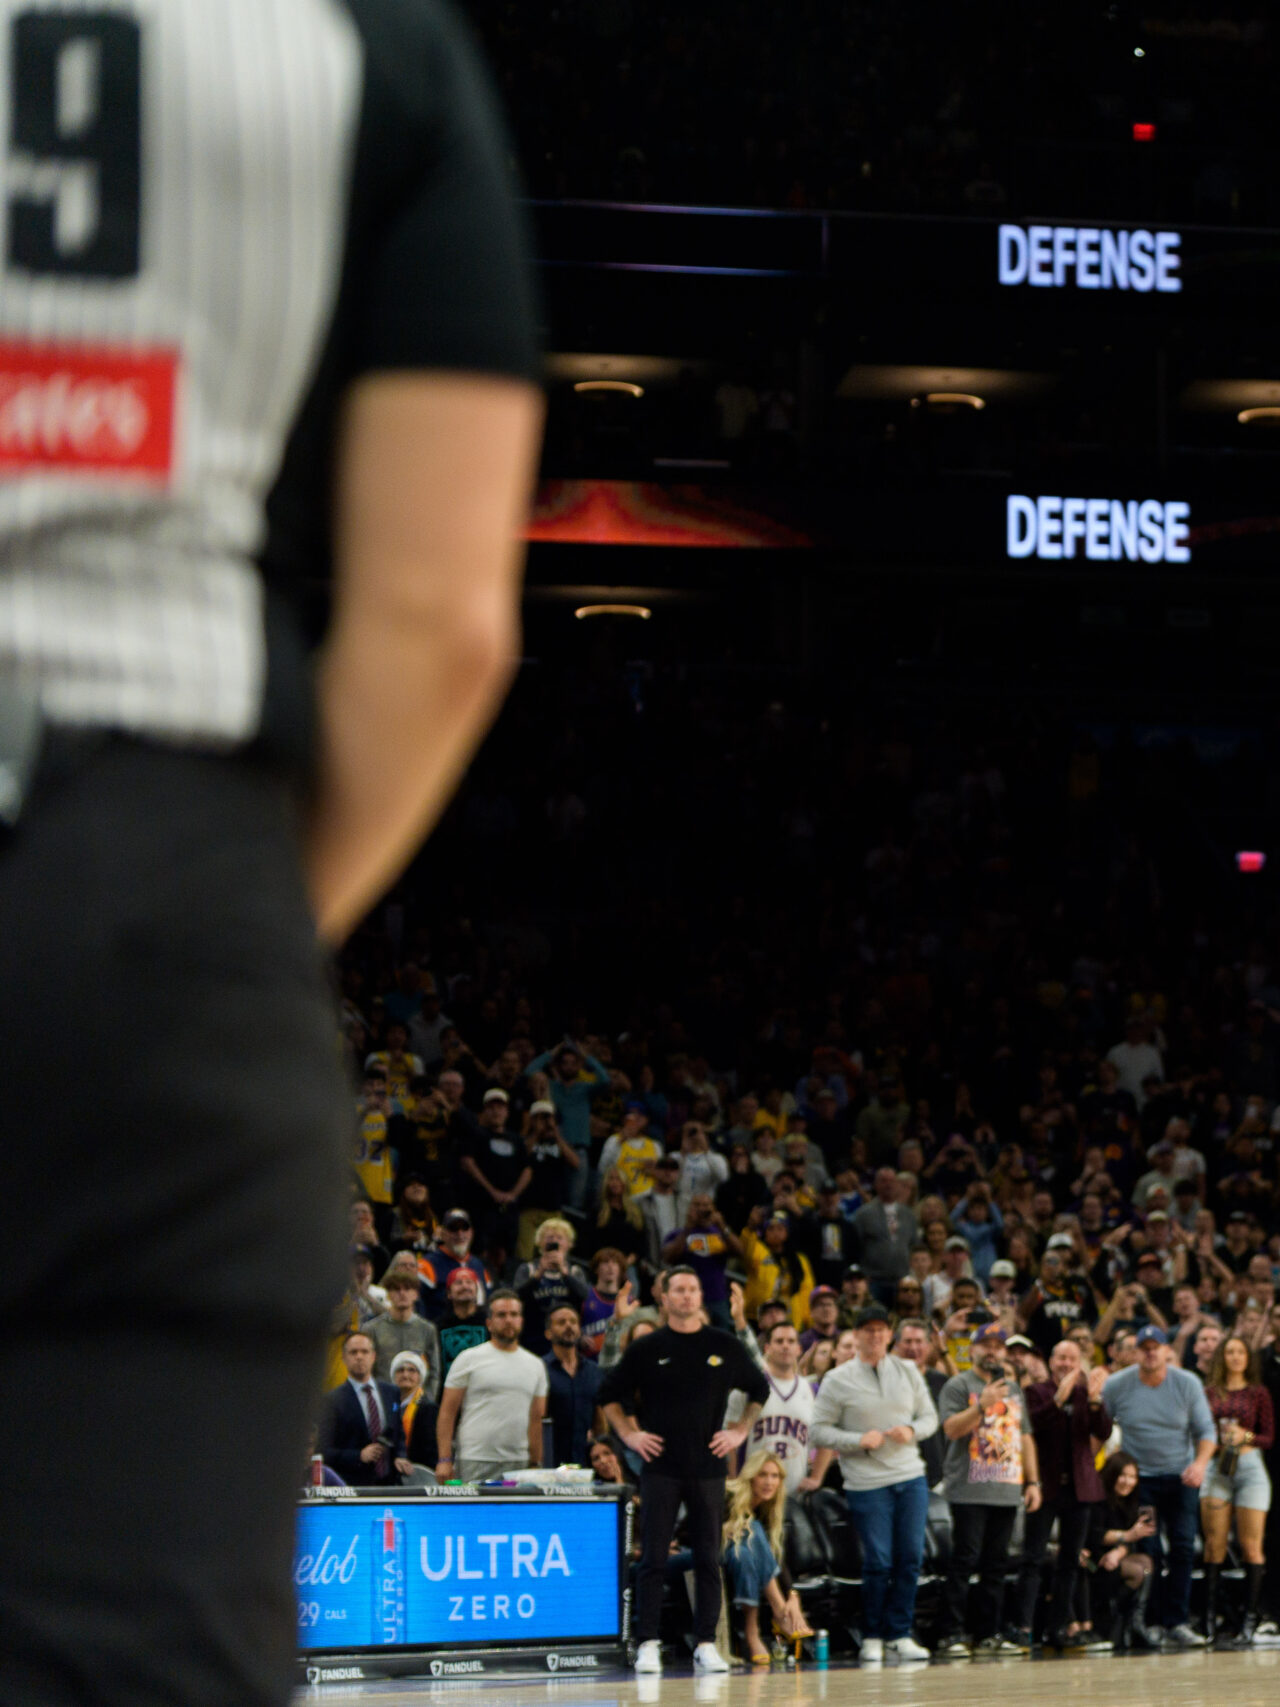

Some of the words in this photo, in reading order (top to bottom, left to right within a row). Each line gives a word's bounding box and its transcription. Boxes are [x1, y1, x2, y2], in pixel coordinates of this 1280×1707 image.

[10, 14, 142, 276] 9
[999, 224, 1182, 292] DEFENSE
[1007, 495, 1191, 563] DEFENSE
[752, 1415, 809, 1446] SUNS
[438, 1486, 478, 1497] FANDUEL
[555, 1486, 594, 1497] FANDUEL
[420, 1534, 570, 1581] ULTRA
[324, 1608, 347, 1620] CALS
[384, 1559, 396, 1643] ULTRA
[448, 1594, 536, 1621] ZERO
[321, 1666, 364, 1681] FANDUEL
[444, 1660, 484, 1674] FANDUEL
[560, 1654, 598, 1668] FANDUEL
